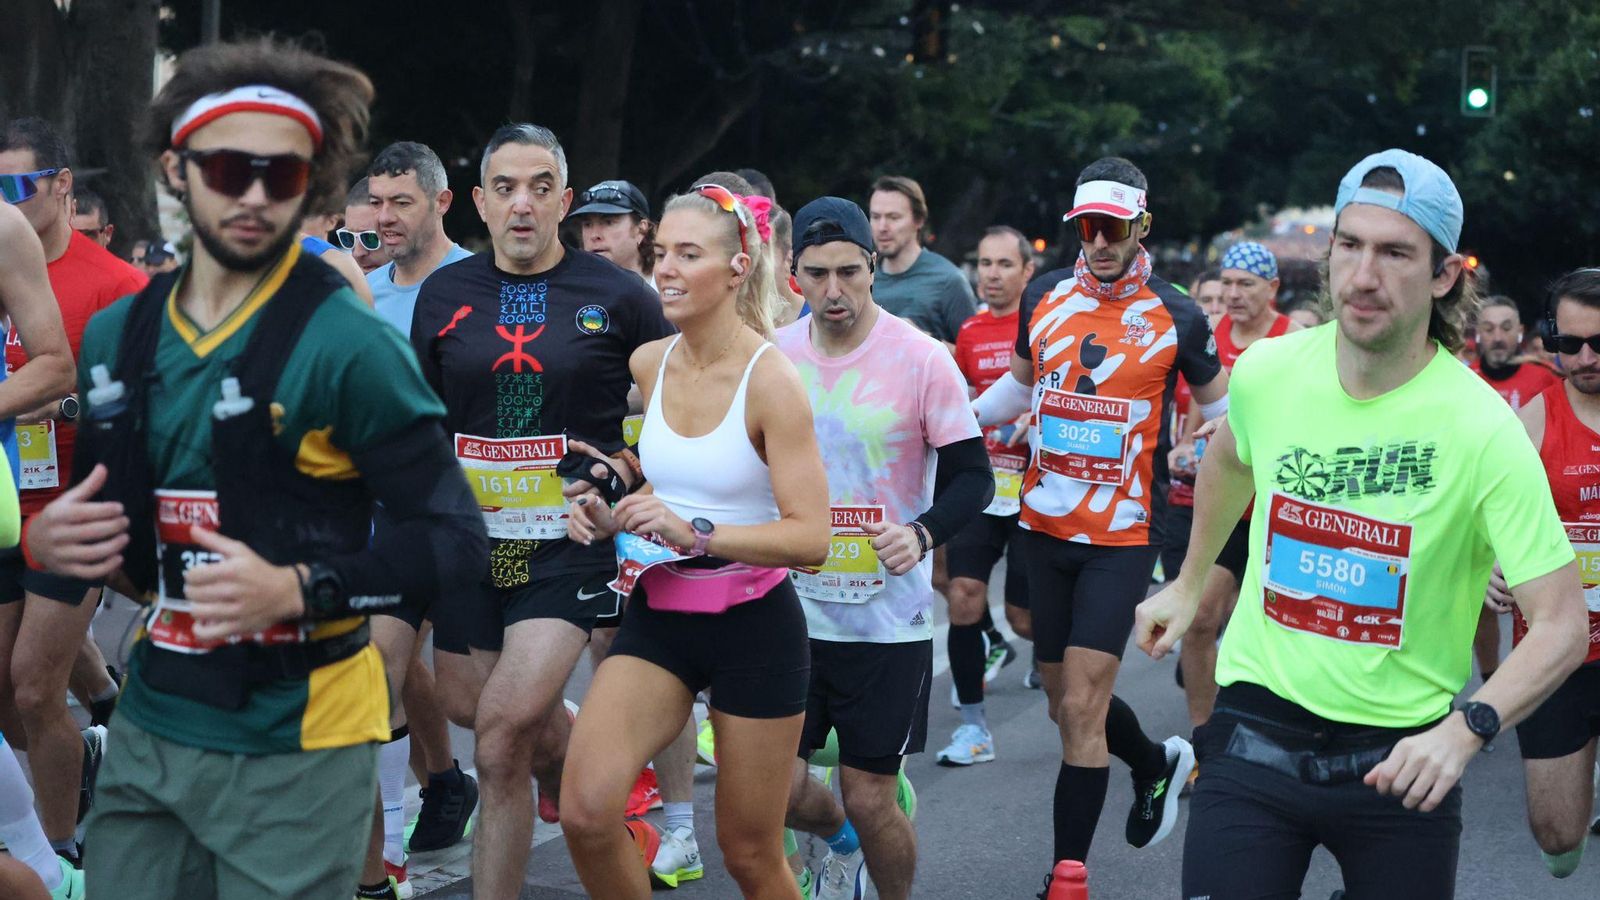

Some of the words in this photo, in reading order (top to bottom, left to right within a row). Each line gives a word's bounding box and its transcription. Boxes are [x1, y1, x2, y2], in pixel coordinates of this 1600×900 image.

[1061, 397, 1123, 416] GENERALI
[1058, 423, 1101, 444] 3026
[482, 442, 556, 459] GENERALI
[479, 475, 542, 494] 16147
[1305, 509, 1402, 547] GENERALI
[1298, 550, 1366, 587] 5580
[1353, 614, 1381, 625] 42K
